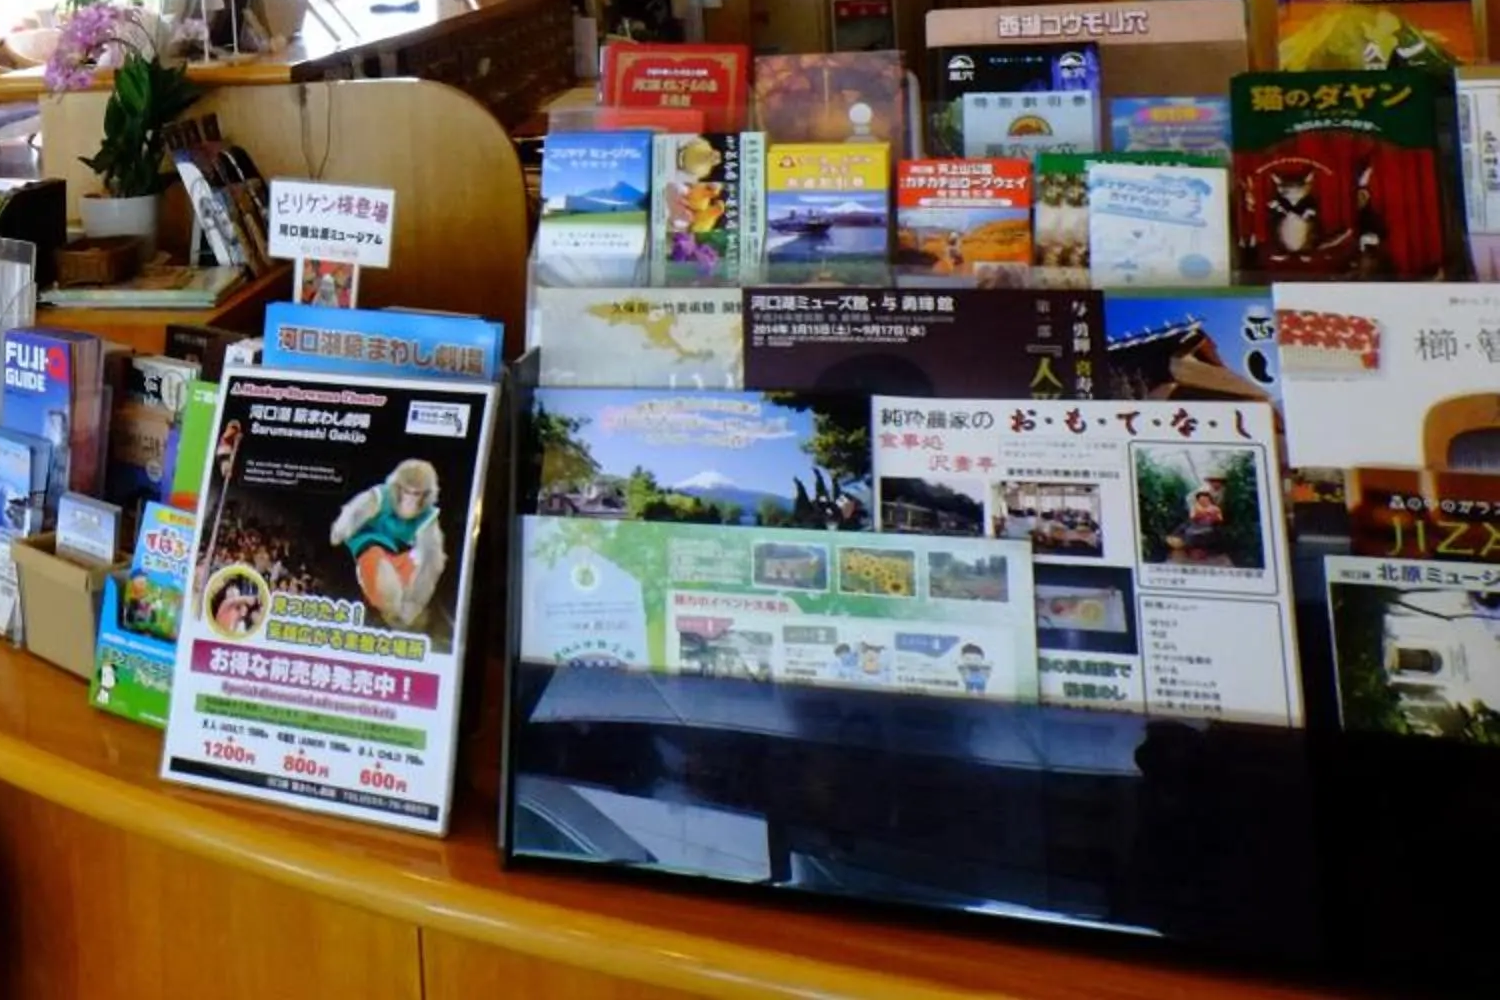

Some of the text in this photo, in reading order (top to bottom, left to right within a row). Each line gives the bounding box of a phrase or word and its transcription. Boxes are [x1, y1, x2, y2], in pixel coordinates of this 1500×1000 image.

[999, 10, 1149, 37] 西湖コウモリ穴
[1251, 84, 1412, 111] 猫のダヤン
[5, 369, 47, 393] GUIDE
[209, 647, 413, 700] お得な前売券発売中！
[203, 740, 256, 765] 1200円
[282, 754, 330, 778] 800円
[359, 768, 408, 794] 600円
